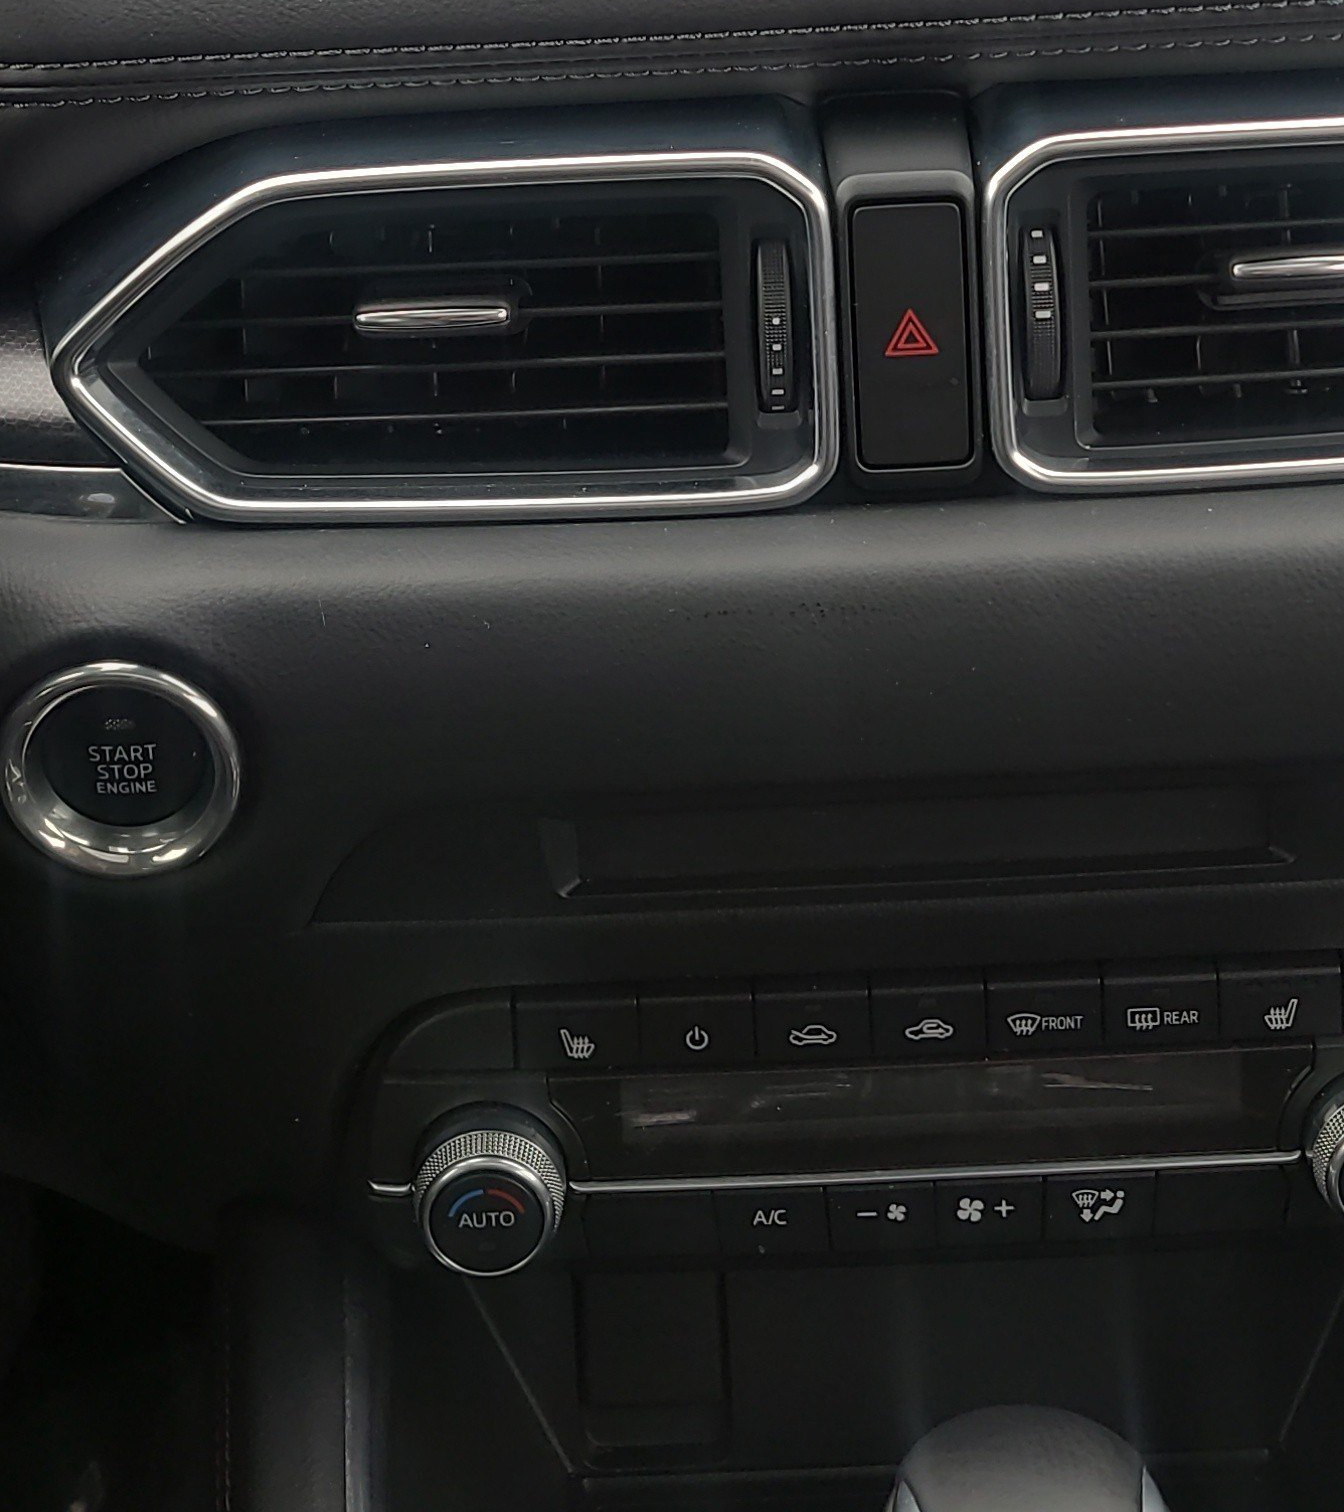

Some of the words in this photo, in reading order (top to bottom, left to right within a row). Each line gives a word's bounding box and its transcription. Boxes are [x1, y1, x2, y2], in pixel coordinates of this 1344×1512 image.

[88, 744, 156, 762] START
[97, 763, 153, 780] STOP
[96, 780, 157, 794] ENGINE
[1042, 1015, 1084, 1031] FRONT
[1163, 1010, 1199, 1026] REAR
[458, 1210, 515, 1229] AUTO
[753, 1209, 787, 1226] A/C
